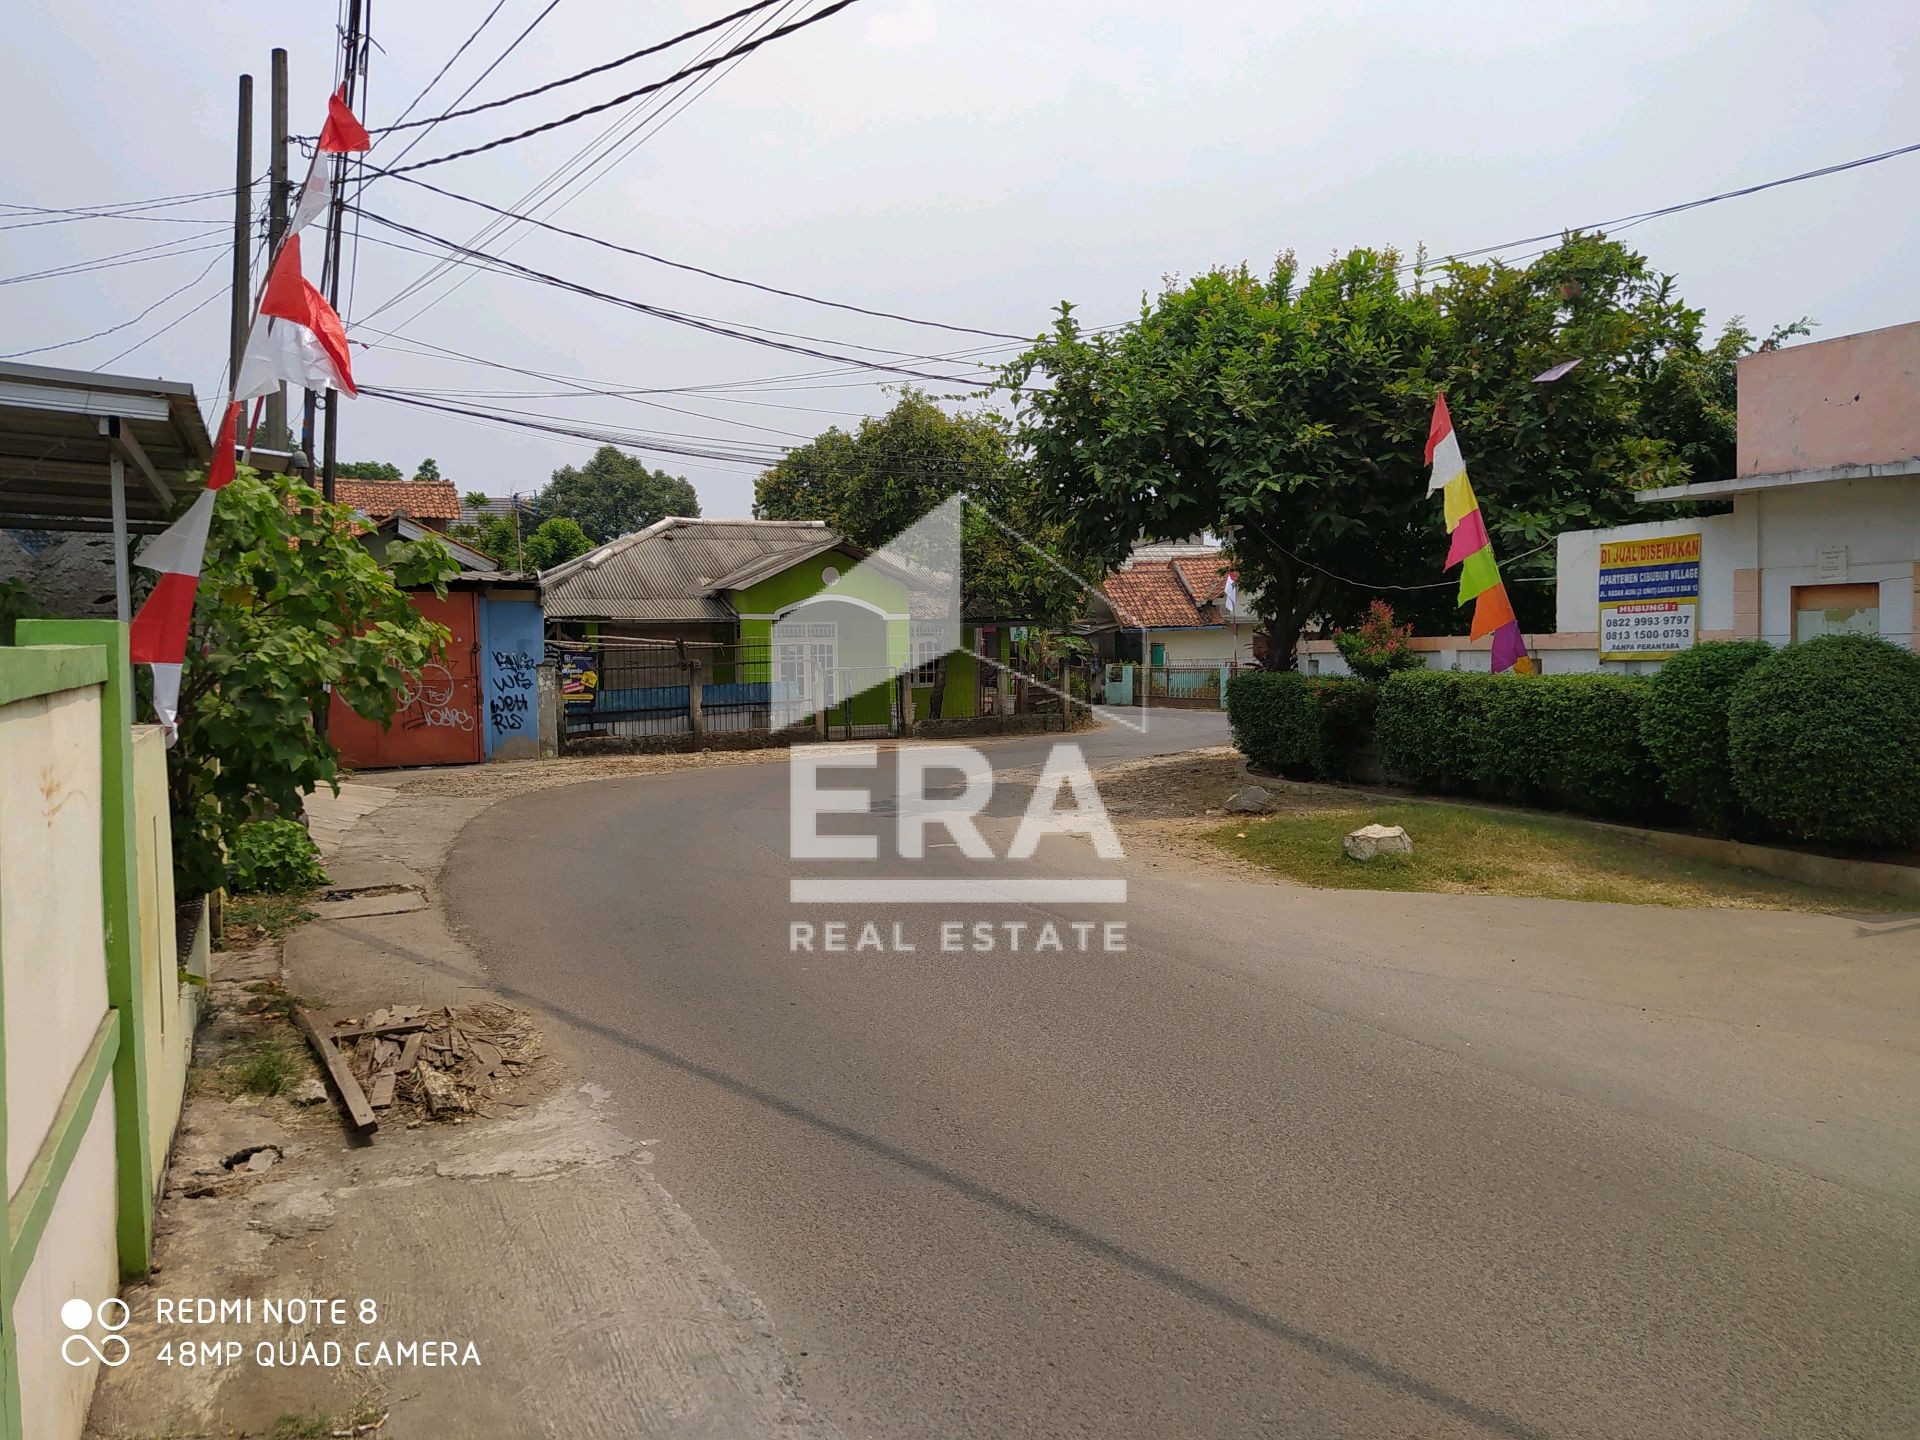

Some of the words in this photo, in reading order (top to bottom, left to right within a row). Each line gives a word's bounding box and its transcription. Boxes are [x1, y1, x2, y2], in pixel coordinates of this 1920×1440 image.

[1600, 572, 1639, 586] APARTEMEN
[1640, 570, 1669, 583] CIBUBUR
[1670, 568, 1699, 580] VILLAGE
[1605, 618, 1631, 628] 0822
[1633, 616, 1660, 627] 9993
[1663, 615, 1690, 625] 9797
[1605, 631, 1631, 641] 0813
[1633, 630, 1659, 640] 1500
[1662, 629, 1689, 639] 0793
[1636, 642, 1680, 650] PERANTARA
